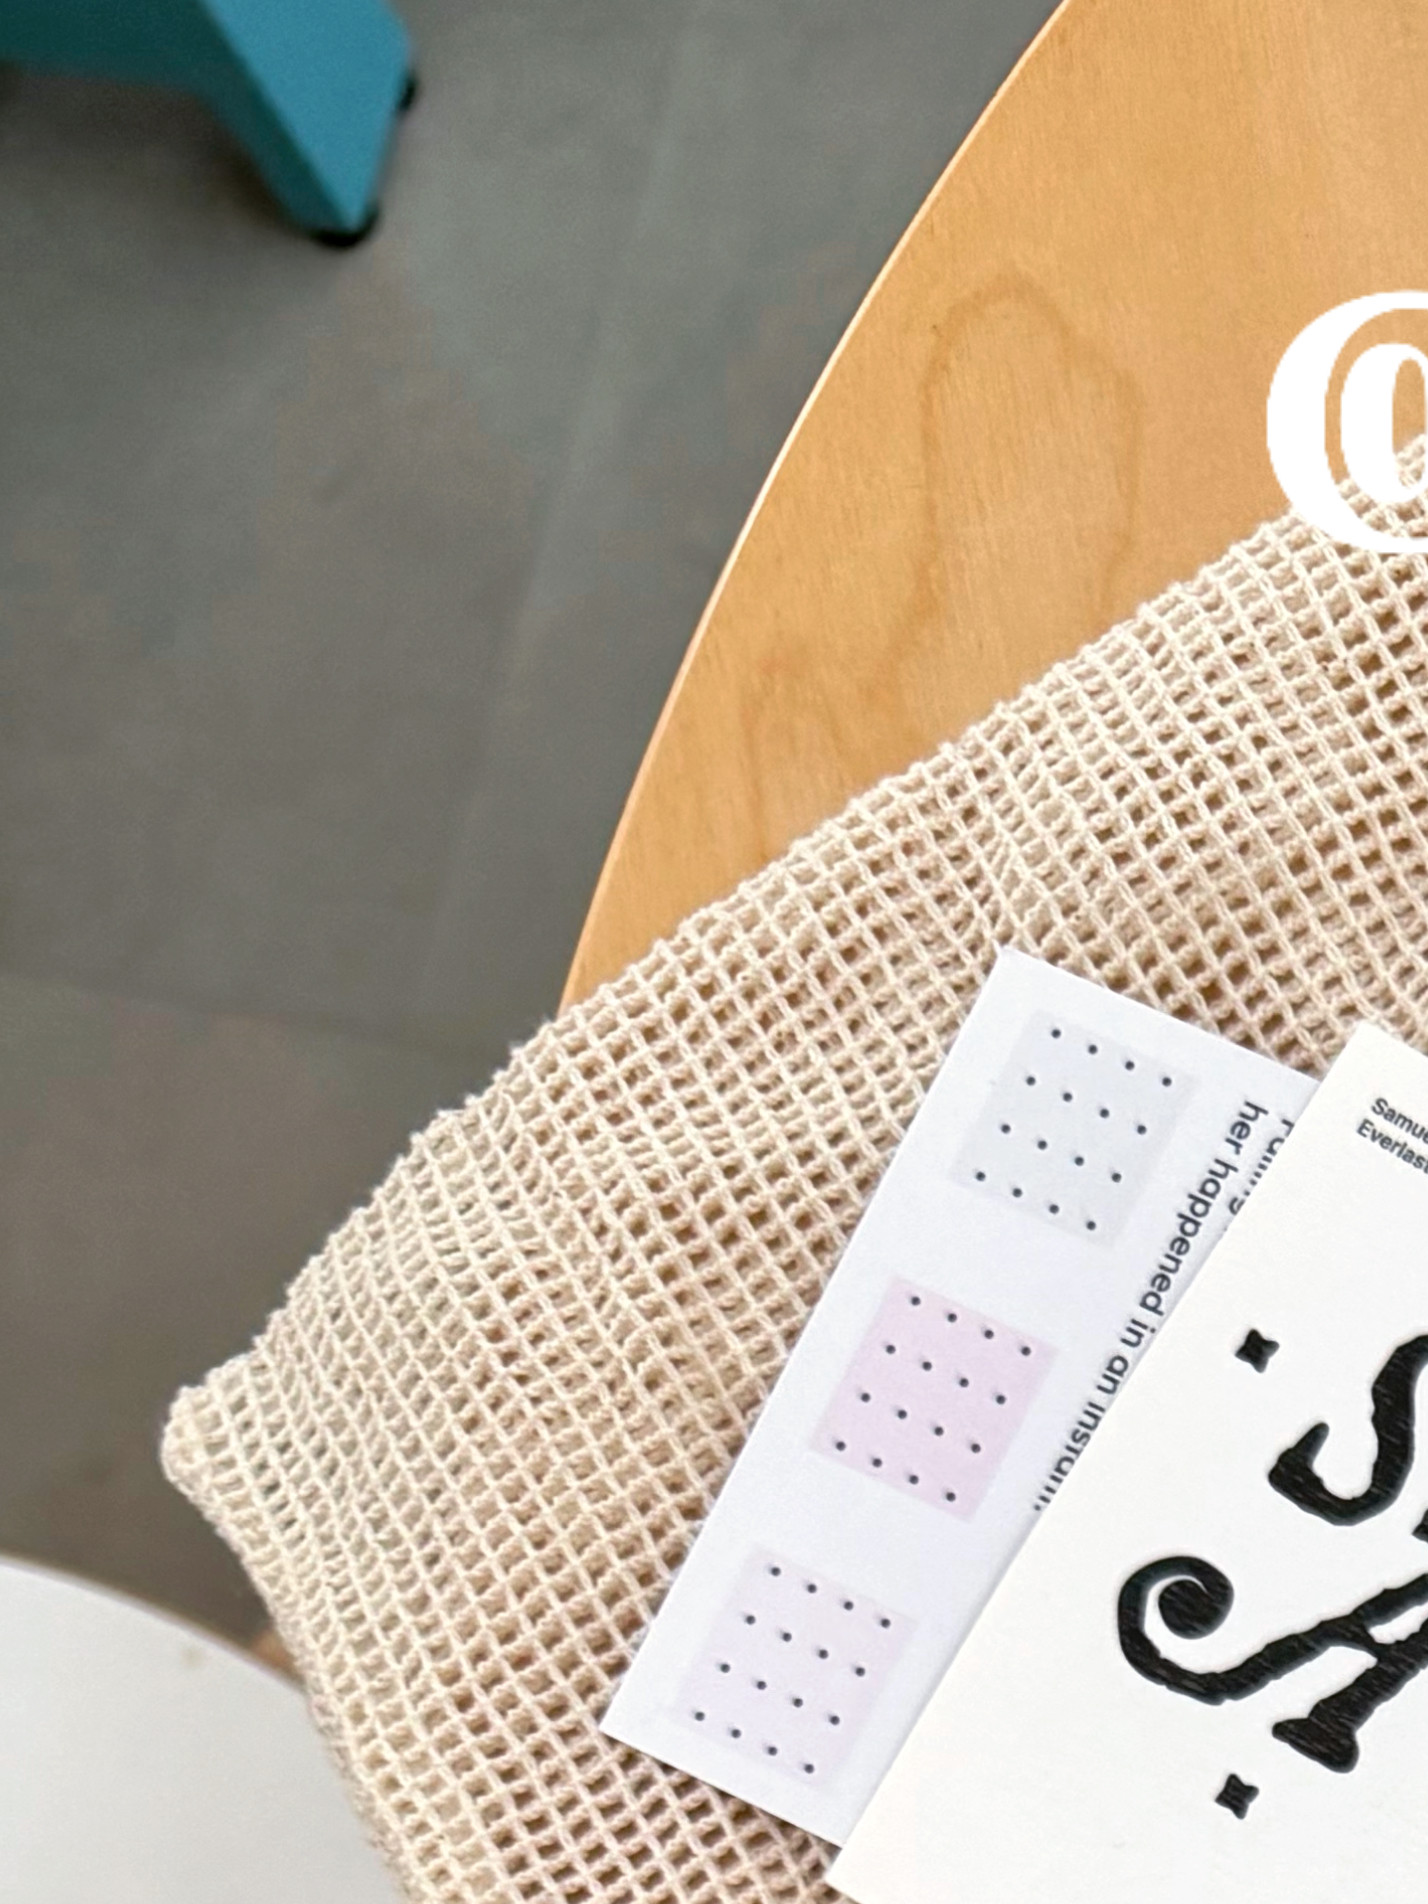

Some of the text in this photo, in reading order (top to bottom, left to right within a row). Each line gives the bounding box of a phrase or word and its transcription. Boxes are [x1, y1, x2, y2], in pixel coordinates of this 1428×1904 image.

[1224, 1100, 1270, 1156] her
[1138, 1157, 1240, 1317] happened
[1119, 1317, 1157, 1349] in
[1095, 1353, 1130, 1396] an
